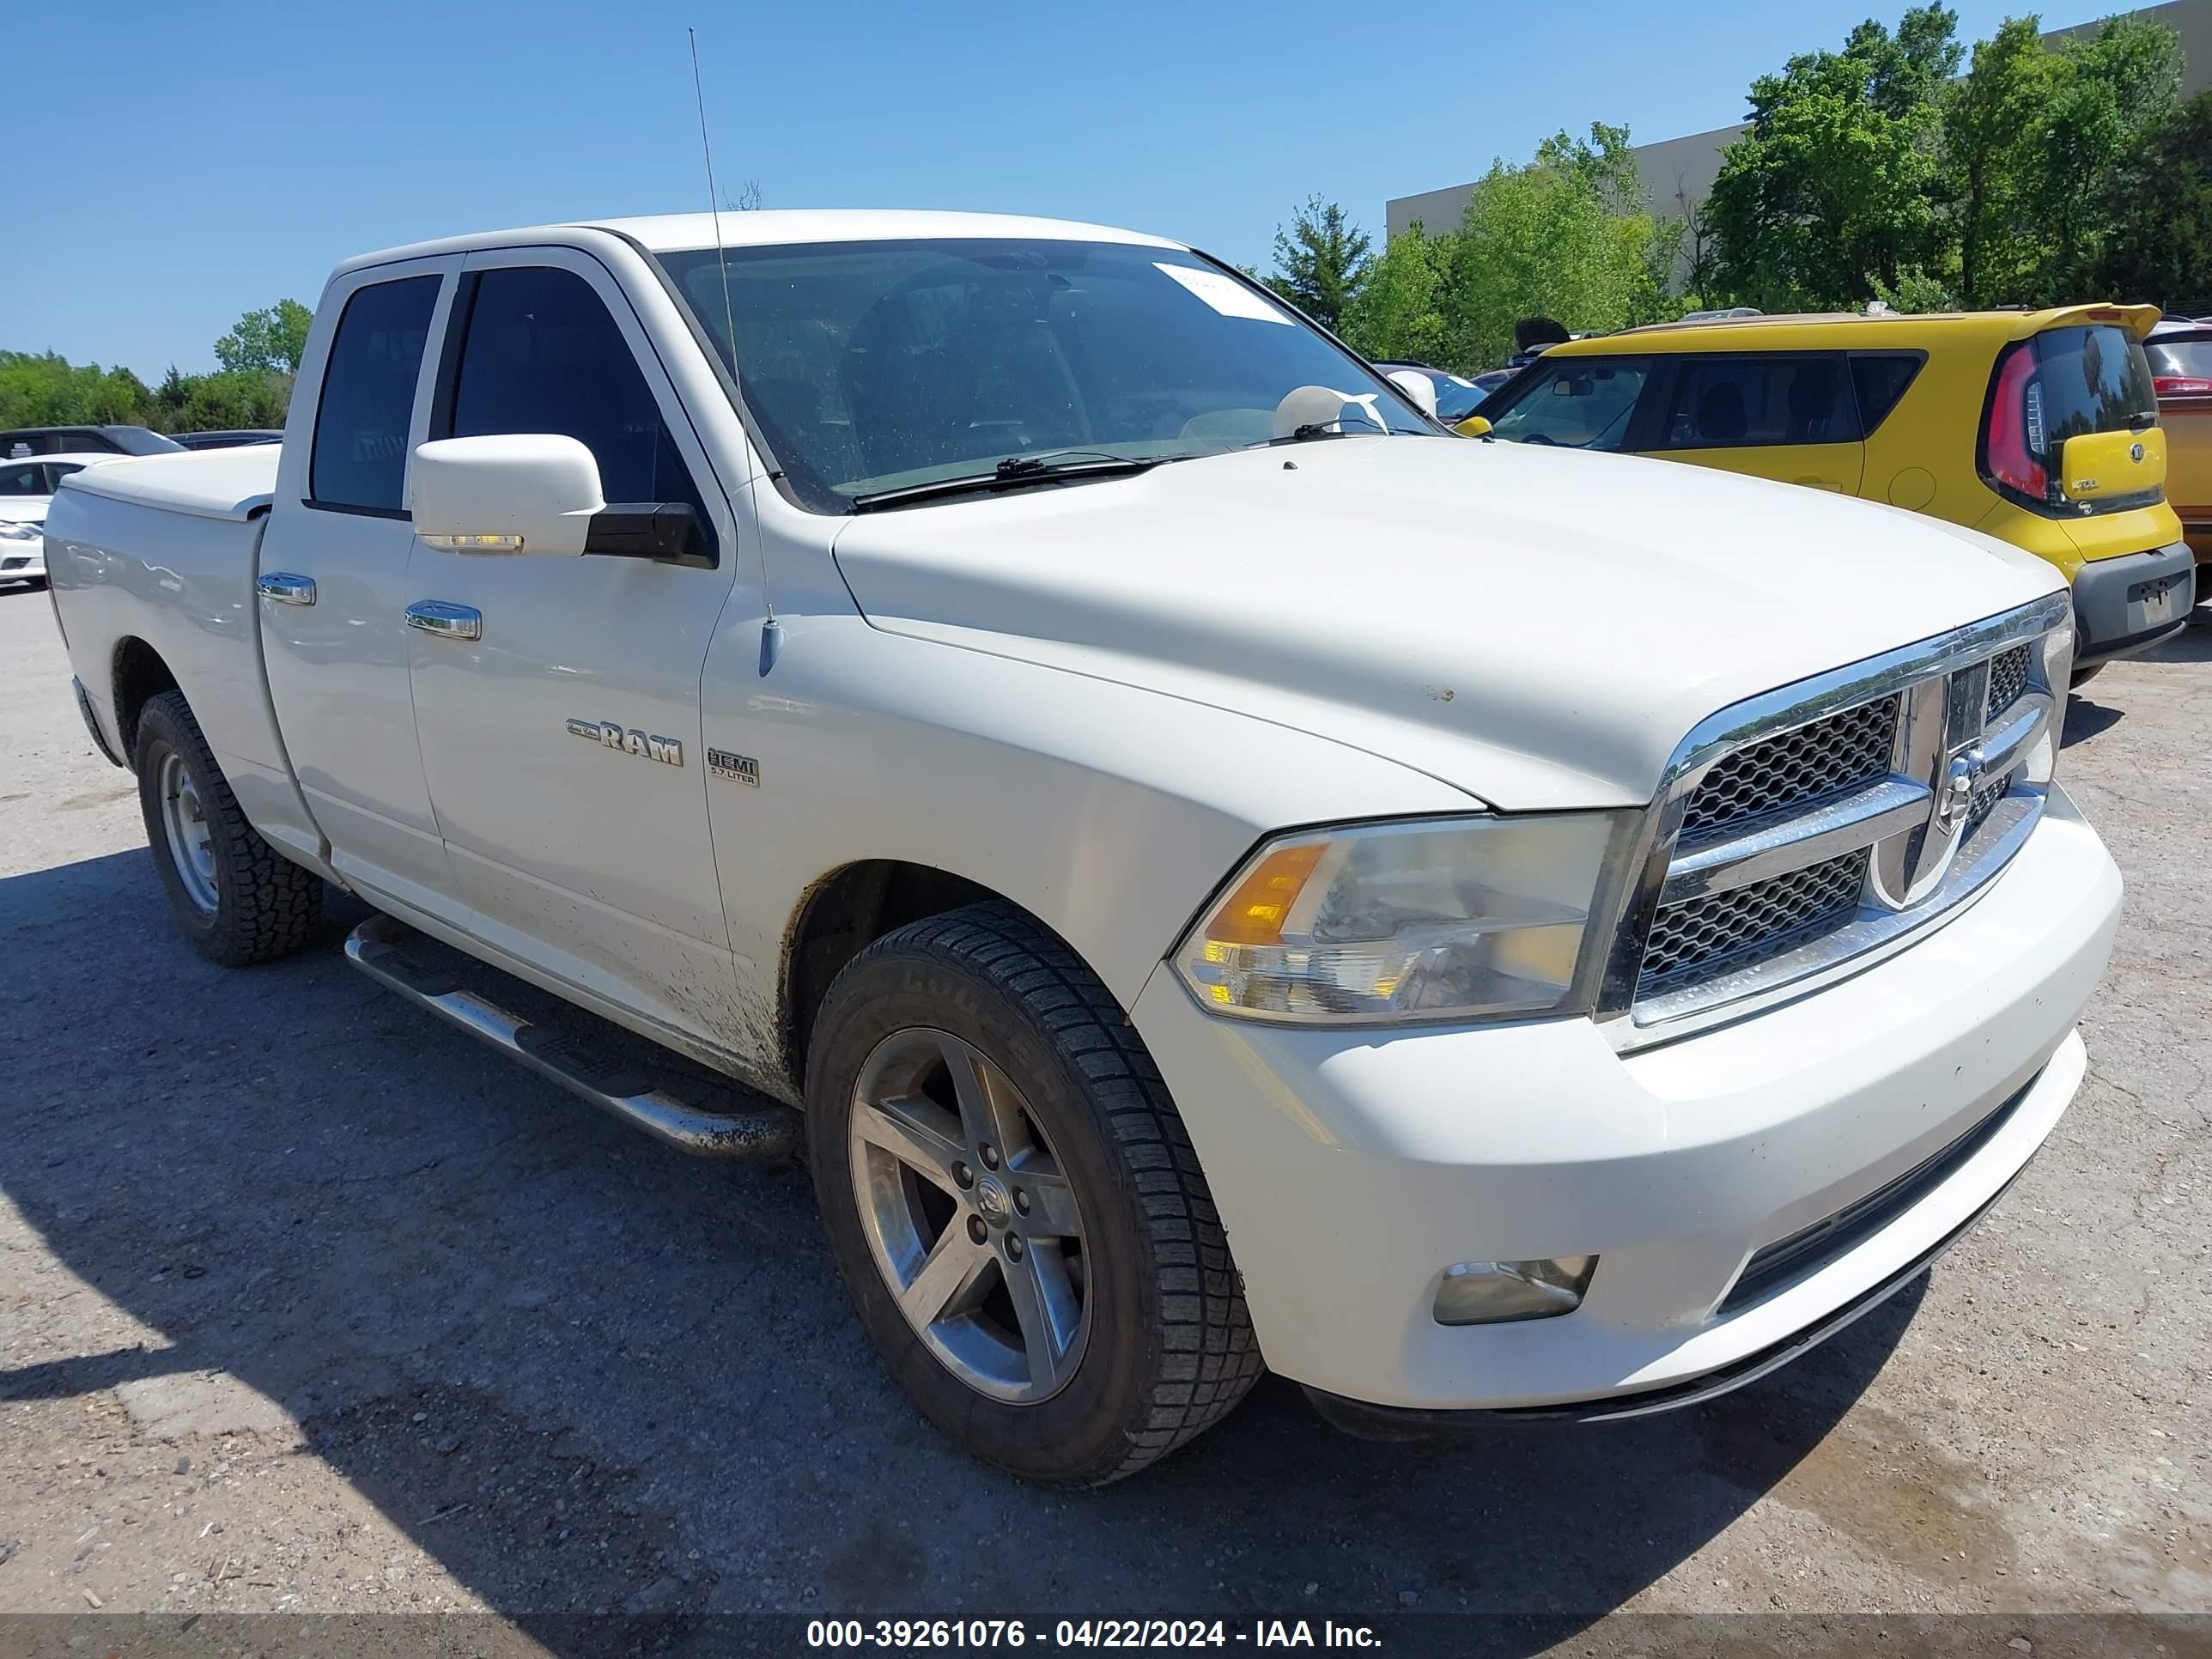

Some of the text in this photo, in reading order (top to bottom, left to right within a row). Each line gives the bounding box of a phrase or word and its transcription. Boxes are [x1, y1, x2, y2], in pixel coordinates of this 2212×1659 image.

[600, 721, 684, 767] RAM
[708, 750, 756, 775] HEMI
[711, 767, 755, 784] 5.7 LITER
